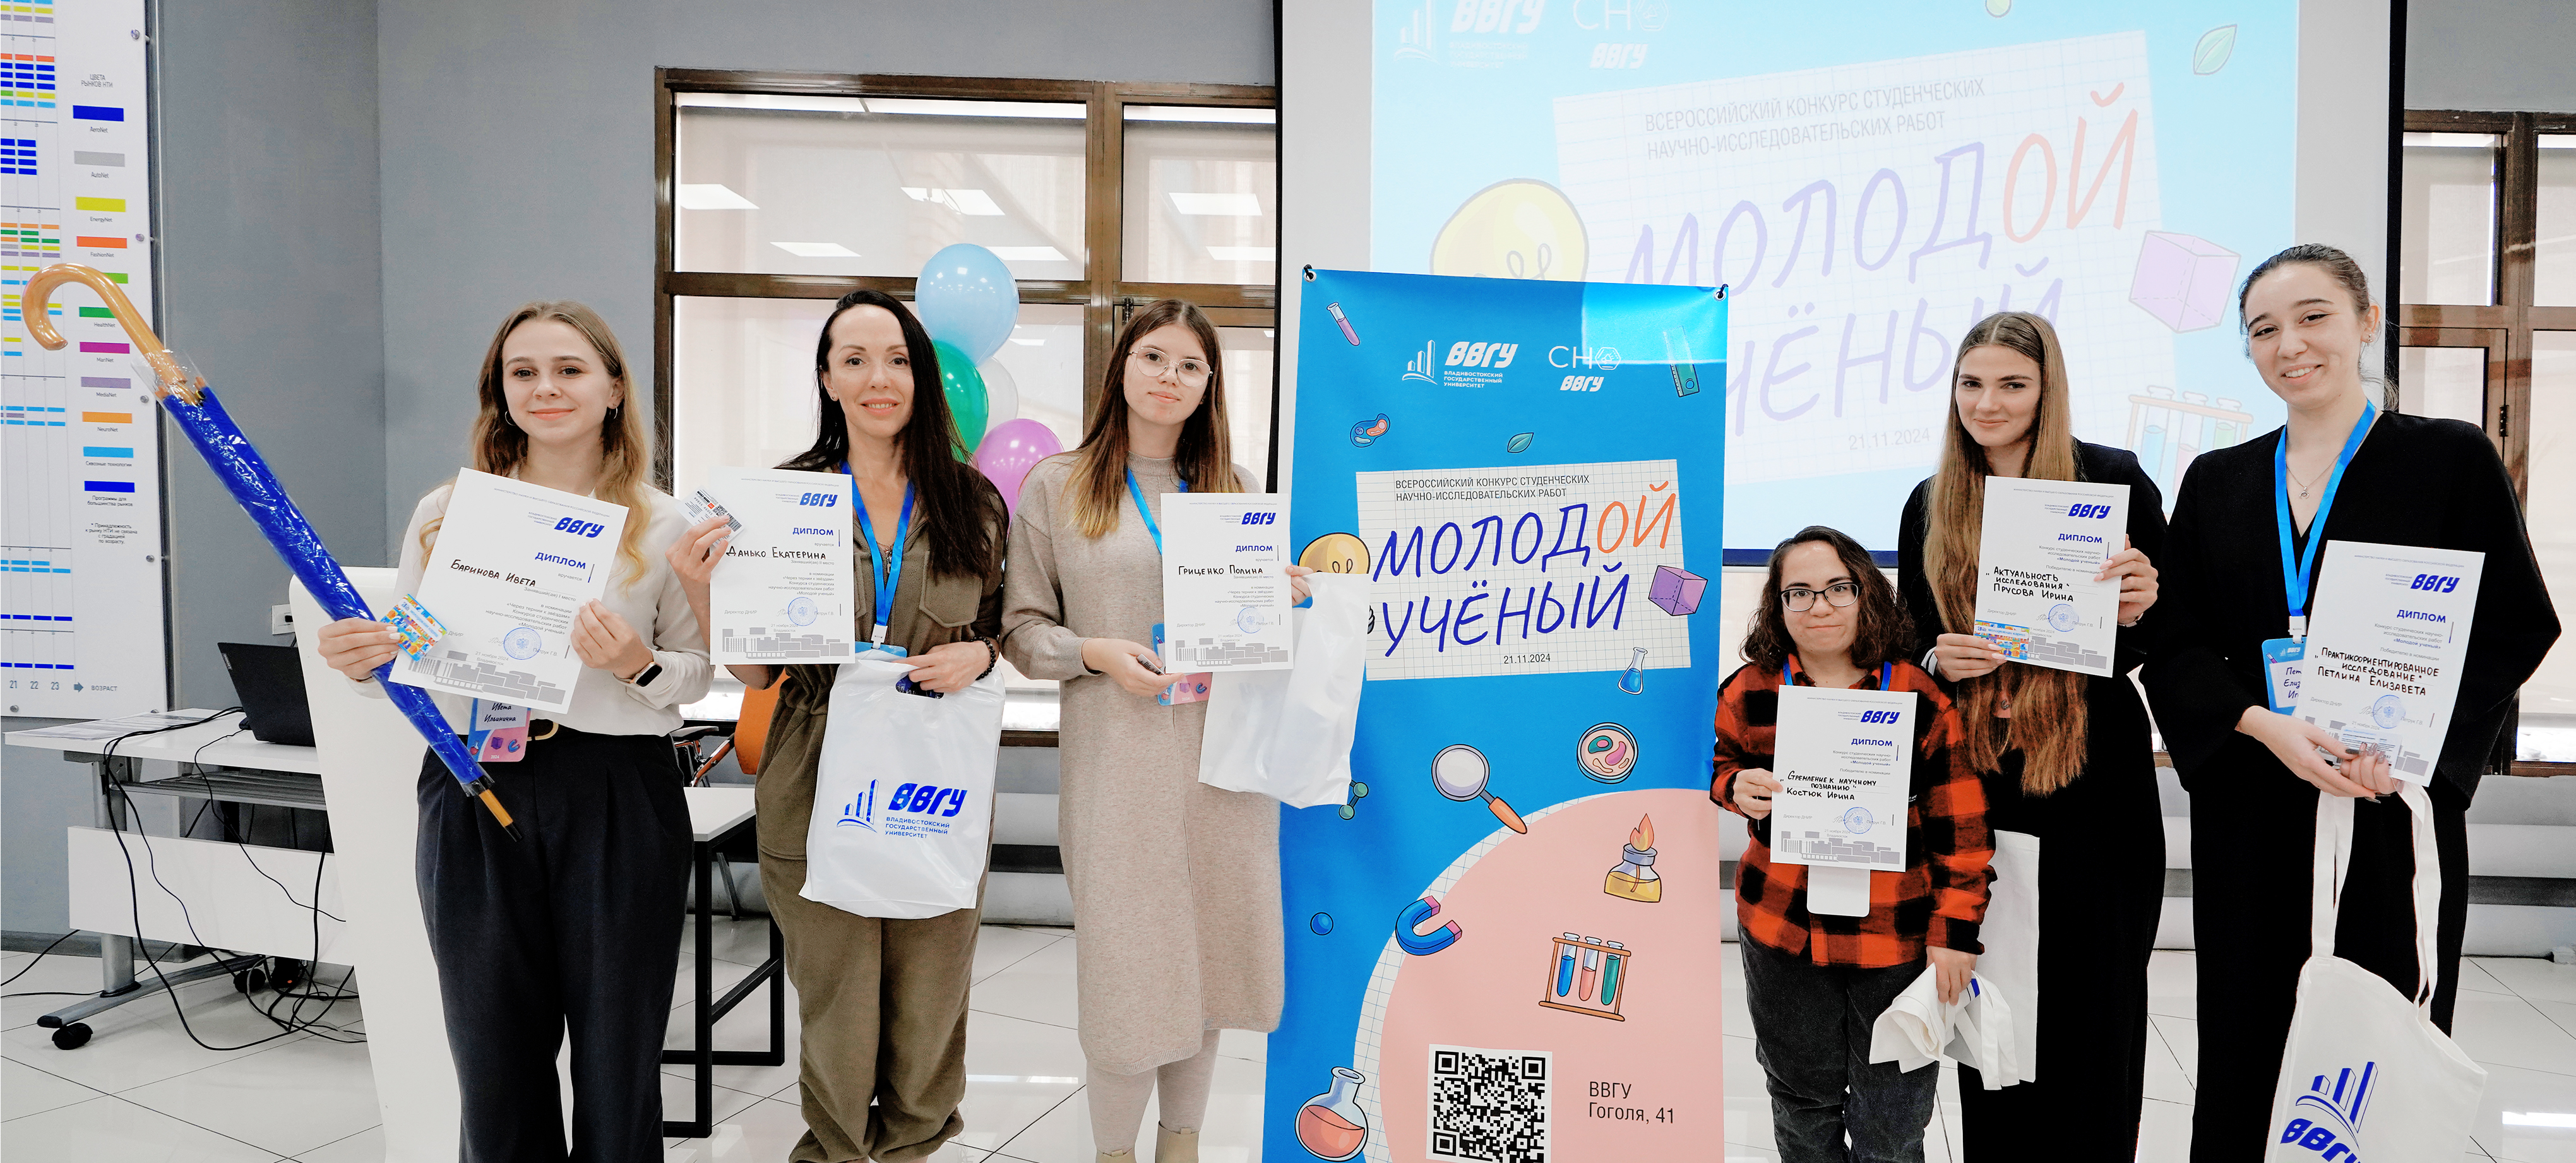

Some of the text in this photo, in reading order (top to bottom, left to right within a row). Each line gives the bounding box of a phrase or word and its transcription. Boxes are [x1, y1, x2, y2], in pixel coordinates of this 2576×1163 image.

[1450, 0, 1546, 33] ВВГУ
[1589, 42, 1649, 70] ВВГУ
[1645, 78, 1986, 132] ВСЕРОССИЙСКИЙ КОНКУРС СТУДЕНЧЕСКИХ
[1647, 110, 1947, 160] НАУЧНО-ИССЛЕДОВАТЕЛЬСКИХ РАБОТ
[1623, 82, 2139, 296] МОЛОДОЙ
[1445, 341, 1519, 368] ВВГУ
[1559, 375, 1605, 392] ВВГУ
[1848, 427, 1931, 451] 21.11.2024
[1395, 475, 1590, 489] ВСЕРОССИЙСКИЙ КОНКУРС СТУДЕНЧЕСКИХ
[799, 492, 838, 508] ВВГУ
[1395, 489, 1566, 501] НАУЧНО-ИССЛЕДОВАТЕЛЬСКИХ РАБОТ
[1241, 512, 1277, 525] ВВГУ
[2068, 503, 2112, 520] ВВГУ
[554, 516, 605, 539] ВВГУ
[792, 527, 834, 536] ДИПЛОМ
[1373, 480, 1676, 582] МОЛОДОЙ
[2058, 533, 2102, 544] ДИПЛОМ
[1235, 545, 1273, 553] ДИПЛОМ
[535, 552, 586, 570] ДИПЛОМ
[557, 573, 583, 582] вручается
[2410, 573, 2460, 593] ВВГУ
[523, 586, 559, 599] Занявший(ая)
[506, 602, 525, 611] «Через
[546, 611, 571, 620] звёздам»
[544, 605, 573, 614] номинации
[1382, 561, 1630, 657] УЧЁНЫЙ
[2397, 609, 2446, 624] ДИПЛОМ
[484, 609, 552, 628] научно-исследовательских
[511, 609, 569, 626] Конкурса студенческих
[518, 621, 566, 636] «Молодой ученый»
[475, 656, 505, 667] Владивосток
[1503, 653, 1551, 664] 21.11.2024
[9, 680, 18, 689] 21
[30, 681, 39, 689] 22
[51, 682, 59, 690] 23
[484, 714, 516, 723] Ильинична
[1860, 710, 1901, 725] ВВГУ
[1851, 738, 1893, 747] ДИПЛОМ
[888, 782, 967, 818] ВВГУ
[885, 823, 948, 835] ГОСУДАРСТВЕННЫЙ
[886, 816, 950, 828] ВЛАДИВОСТОКСКИЙ
[885, 830, 928, 838] УНИВЕРСИТЕТ
[1590, 1081, 1632, 1099] ВВГУ
[1589, 1102, 1674, 1124] Гоголя, 41
